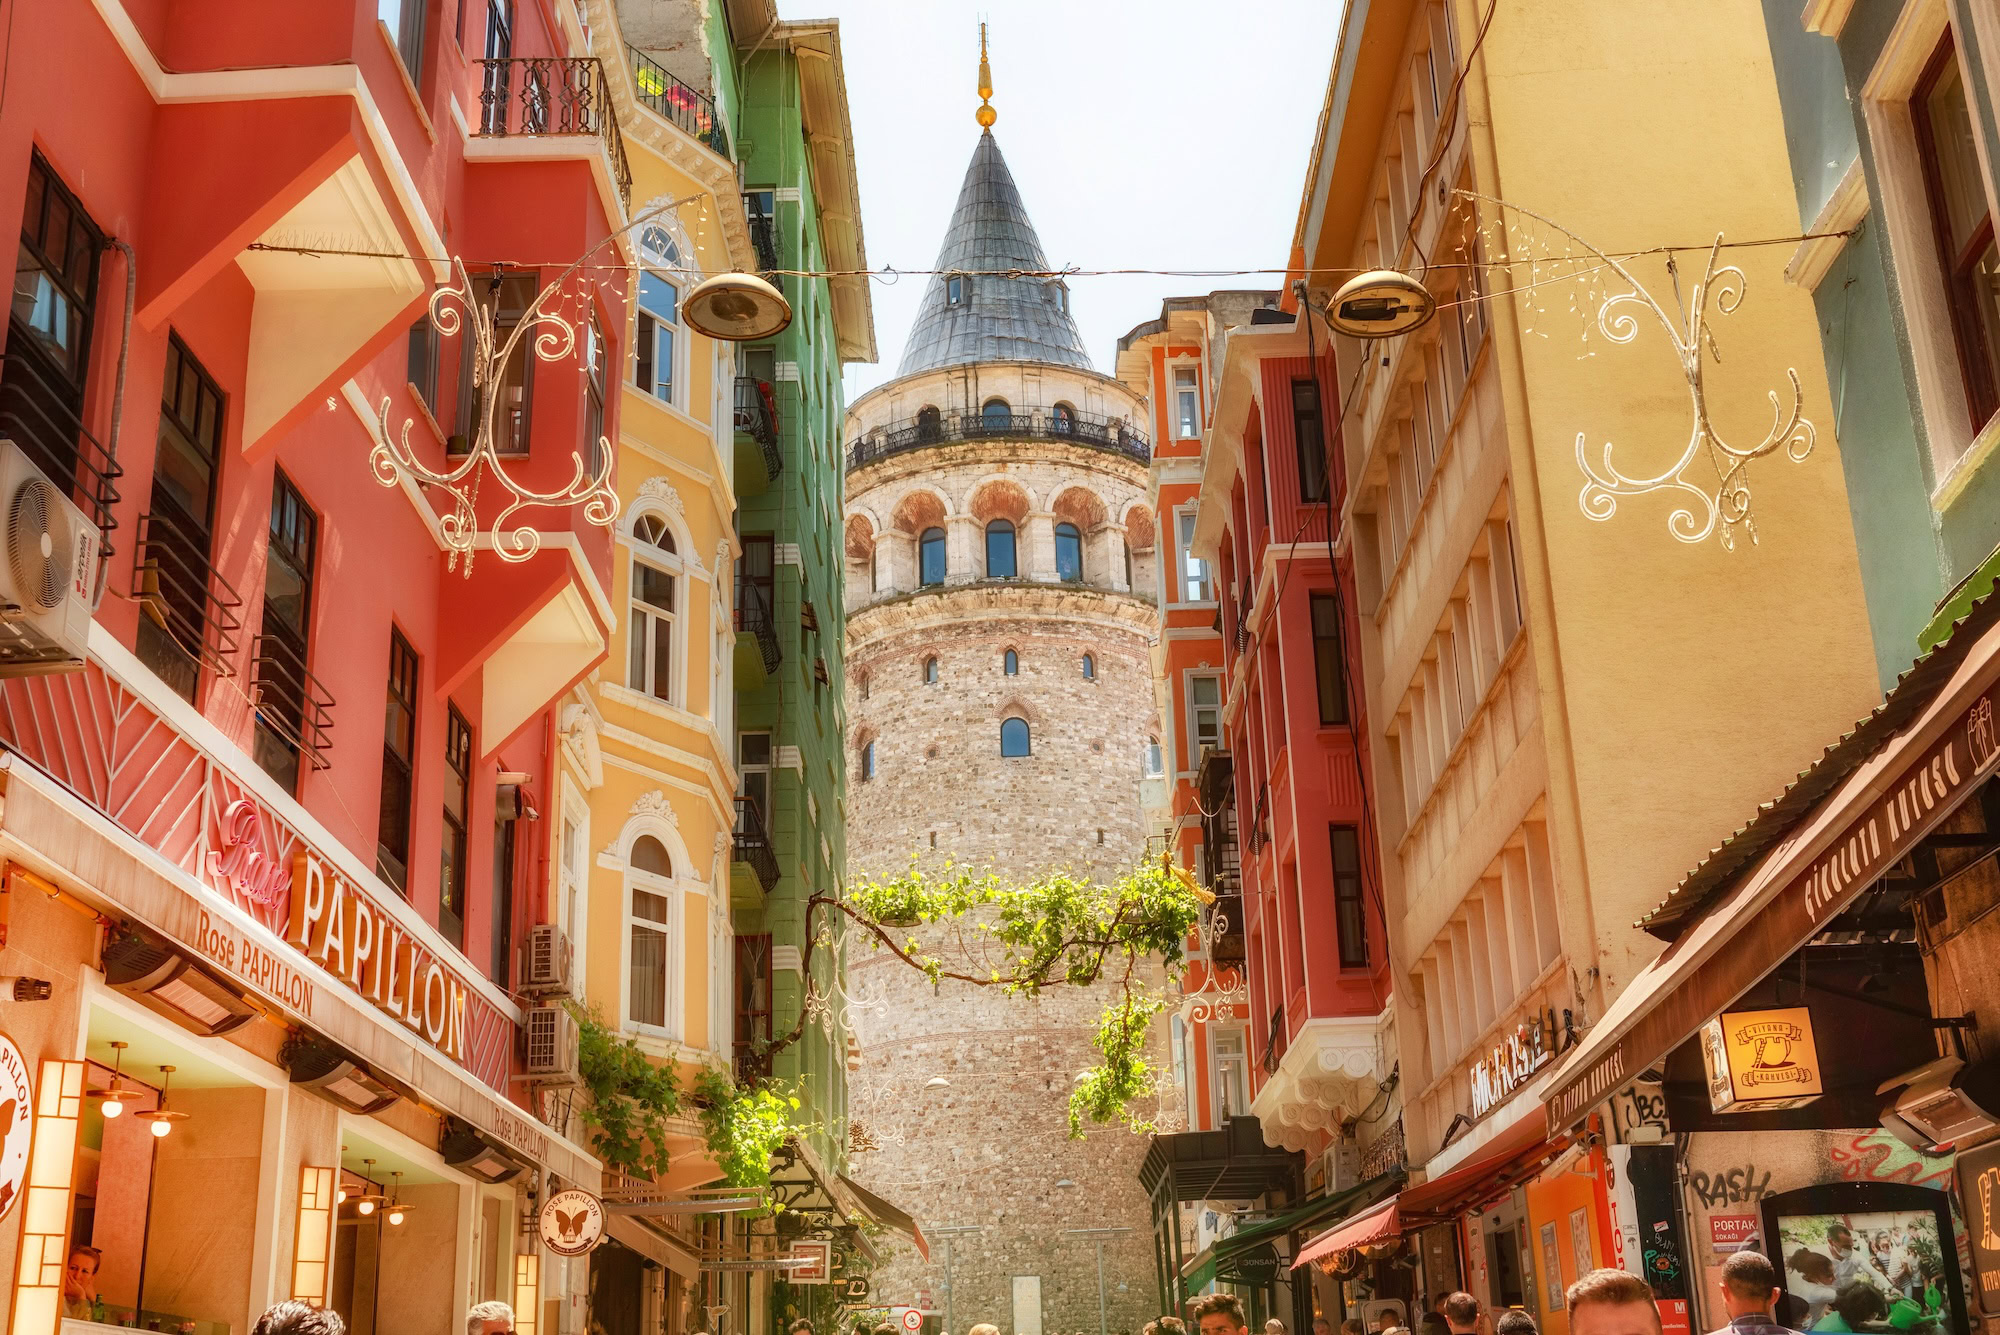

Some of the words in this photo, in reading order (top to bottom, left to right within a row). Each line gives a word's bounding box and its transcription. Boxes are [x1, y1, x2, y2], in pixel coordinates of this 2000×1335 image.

[1887, 742, 1960, 842] KUTUSU
[197, 908, 234, 966] Rose
[240, 938, 314, 1018] PAPILLON
[293, 852, 467, 1063] PAPILLON
[0, 1047, 28, 1121] PILLON
[494, 1108, 511, 1139] Rose
[513, 1121, 549, 1163] PAPILLON
[545, 1197, 563, 1217] ROSE
[564, 1193, 599, 1217] PAPILLON
[1713, 1220, 1758, 1231] PORTAK
